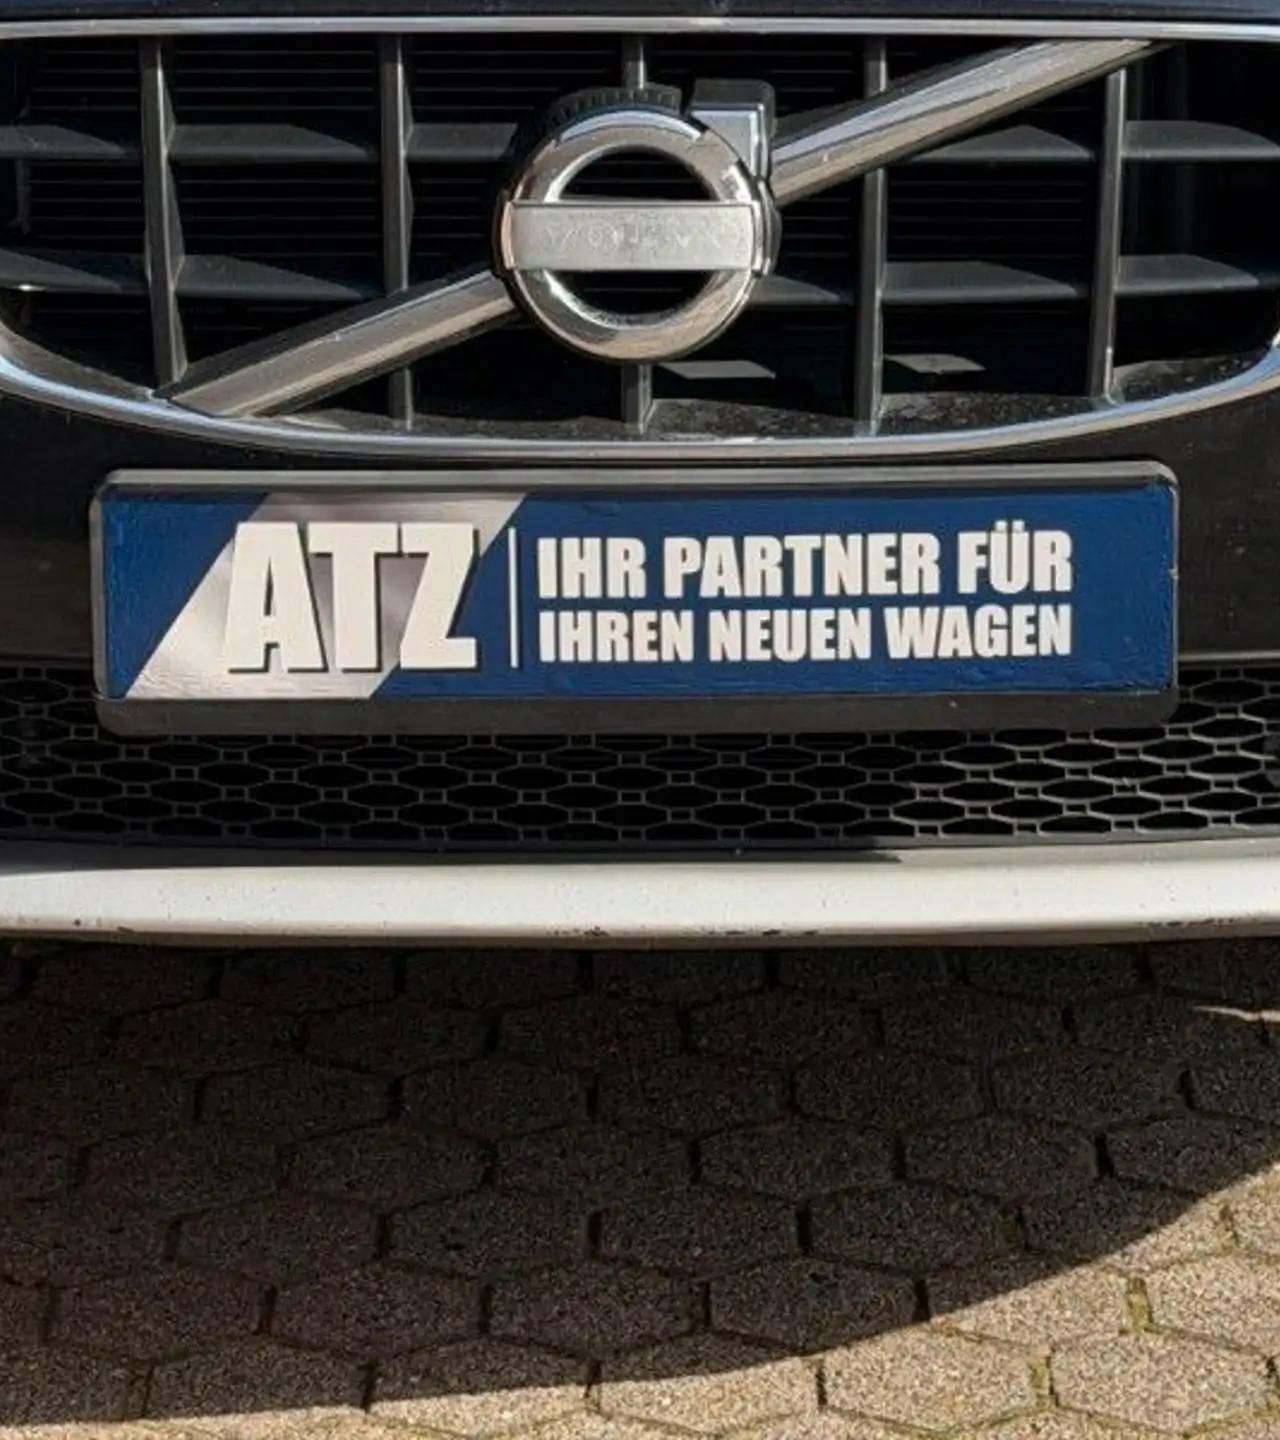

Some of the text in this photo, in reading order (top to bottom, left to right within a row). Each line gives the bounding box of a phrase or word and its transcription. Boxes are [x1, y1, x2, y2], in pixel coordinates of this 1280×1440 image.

[227, 521, 478, 672] ATZ
[537, 519, 1073, 600] IHR PARTNER FÜR
[538, 602, 1072, 663] IHREN NEUEN WAGEN
